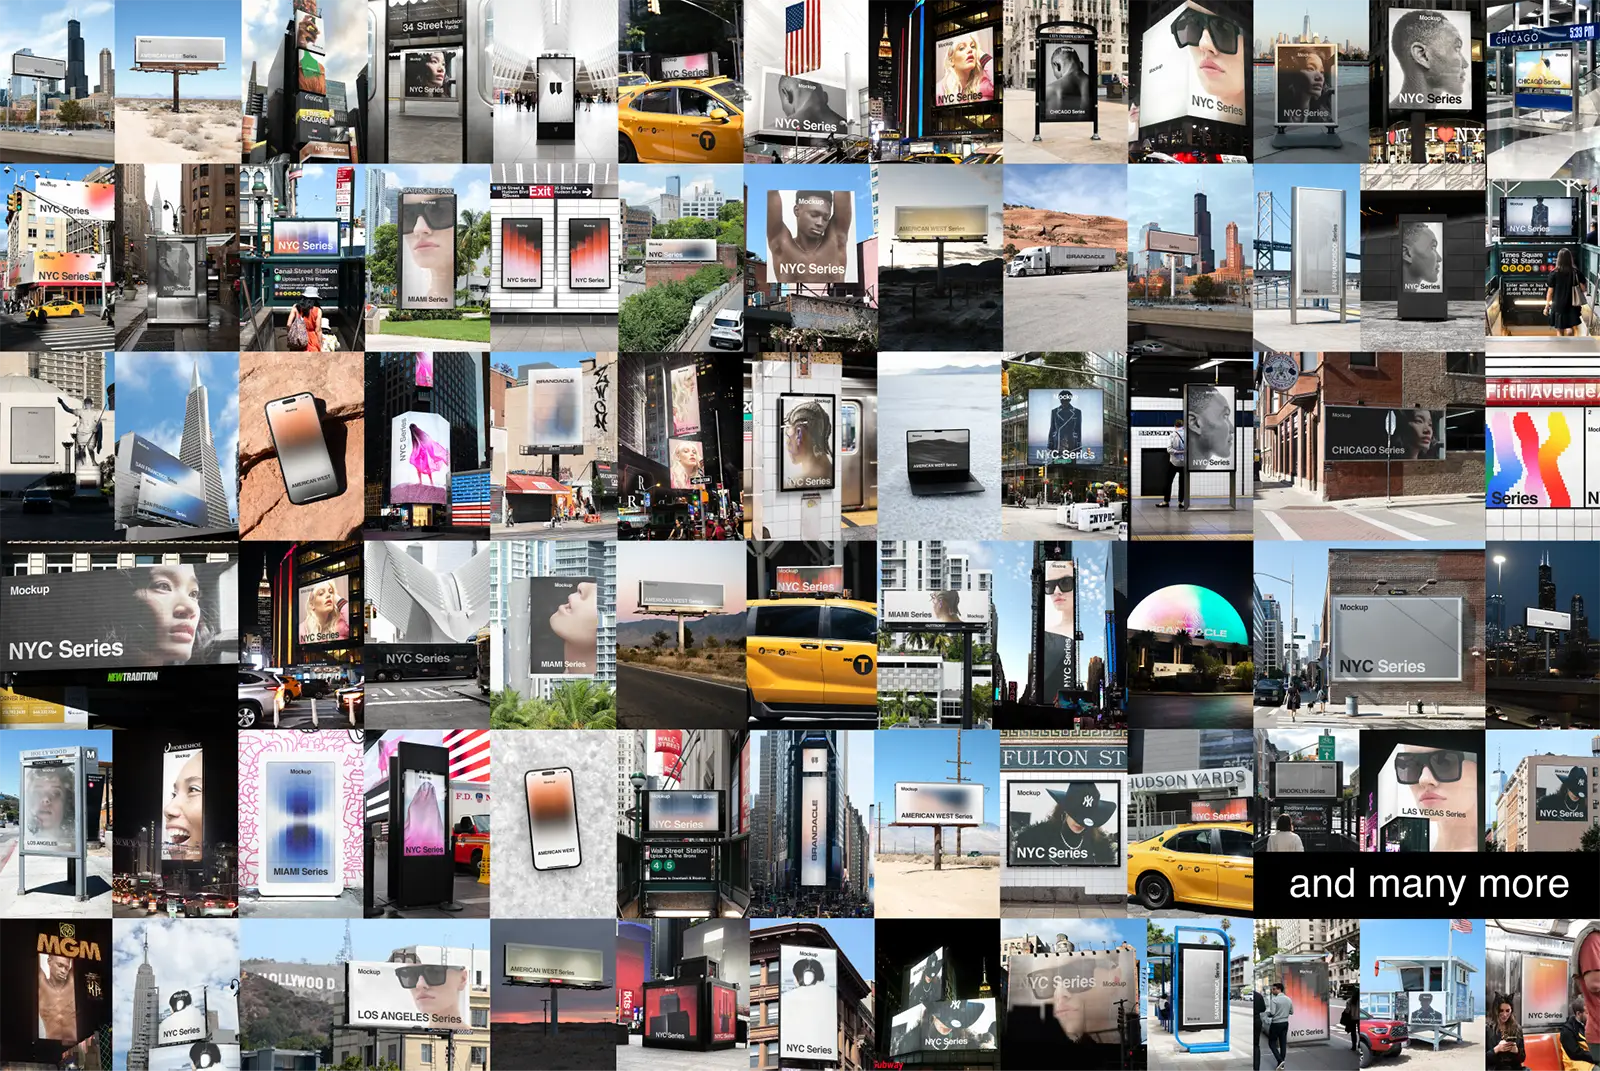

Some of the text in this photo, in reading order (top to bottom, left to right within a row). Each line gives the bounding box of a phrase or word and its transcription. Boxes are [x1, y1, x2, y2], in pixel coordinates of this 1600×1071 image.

[1419, 14, 1441, 22] Mockup
[402, 21, 443, 32] 34 Street
[1496, 27, 1594, 44] CHICAGO 5:33 PM
[938, 92, 982, 103] NYC Series
[1399, 94, 1462, 104] NYC Series
[1192, 95, 1243, 116] NYC Series
[775, 119, 837, 131] NYC Series
[703, 134, 712, 148] T
[1395, 129, 1408, 143] NY
[1455, 128, 1484, 143] NY
[530, 186, 552, 197] Exit
[40, 204, 89, 215] NYC Series
[1528, 225, 1549, 233] Series
[279, 241, 334, 251] NYC Series
[780, 263, 844, 274] NYC Series
[38, 271, 89, 281] NYC Series
[1486, 384, 1594, 399] Fifth Avenue
[399, 418, 407, 461] NYC Series
[1036, 449, 1059, 460] NYC
[1332, 446, 1405, 454] CHICAGO Series
[806, 477, 831, 486] Series
[1492, 491, 1538, 505] Series
[10, 585, 49, 596] Mockup
[1340, 604, 1368, 612] Mockup
[9, 639, 124, 660] NYC Series
[386, 653, 450, 663] NYC Series
[858, 658, 867, 672] T
[1340, 660, 1425, 673] NYC Series
[108, 672, 158, 682] NEWTRADITION
[1004, 750, 1125, 766] FULTON ST
[1192, 771, 1244, 784] YARDS
[1419, 809, 1444, 817] VEGAS
[1540, 810, 1584, 818] NYC Series
[674, 820, 703, 829] Series
[1017, 847, 1088, 859] NYC Series
[654, 862, 672, 870] 4 5
[302, 868, 328, 876] Series
[37, 934, 101, 961] MGM
[358, 968, 380, 976] Mockup
[1052, 976, 1096, 989] Series
[358, 1010, 462, 1024] LOS ANGELES Series
[163, 1027, 200, 1038] NYC Series
[1306, 1028, 1323, 1036] Series
[943, 1038, 967, 1046] Series
[787, 1044, 832, 1054] NYC Series
